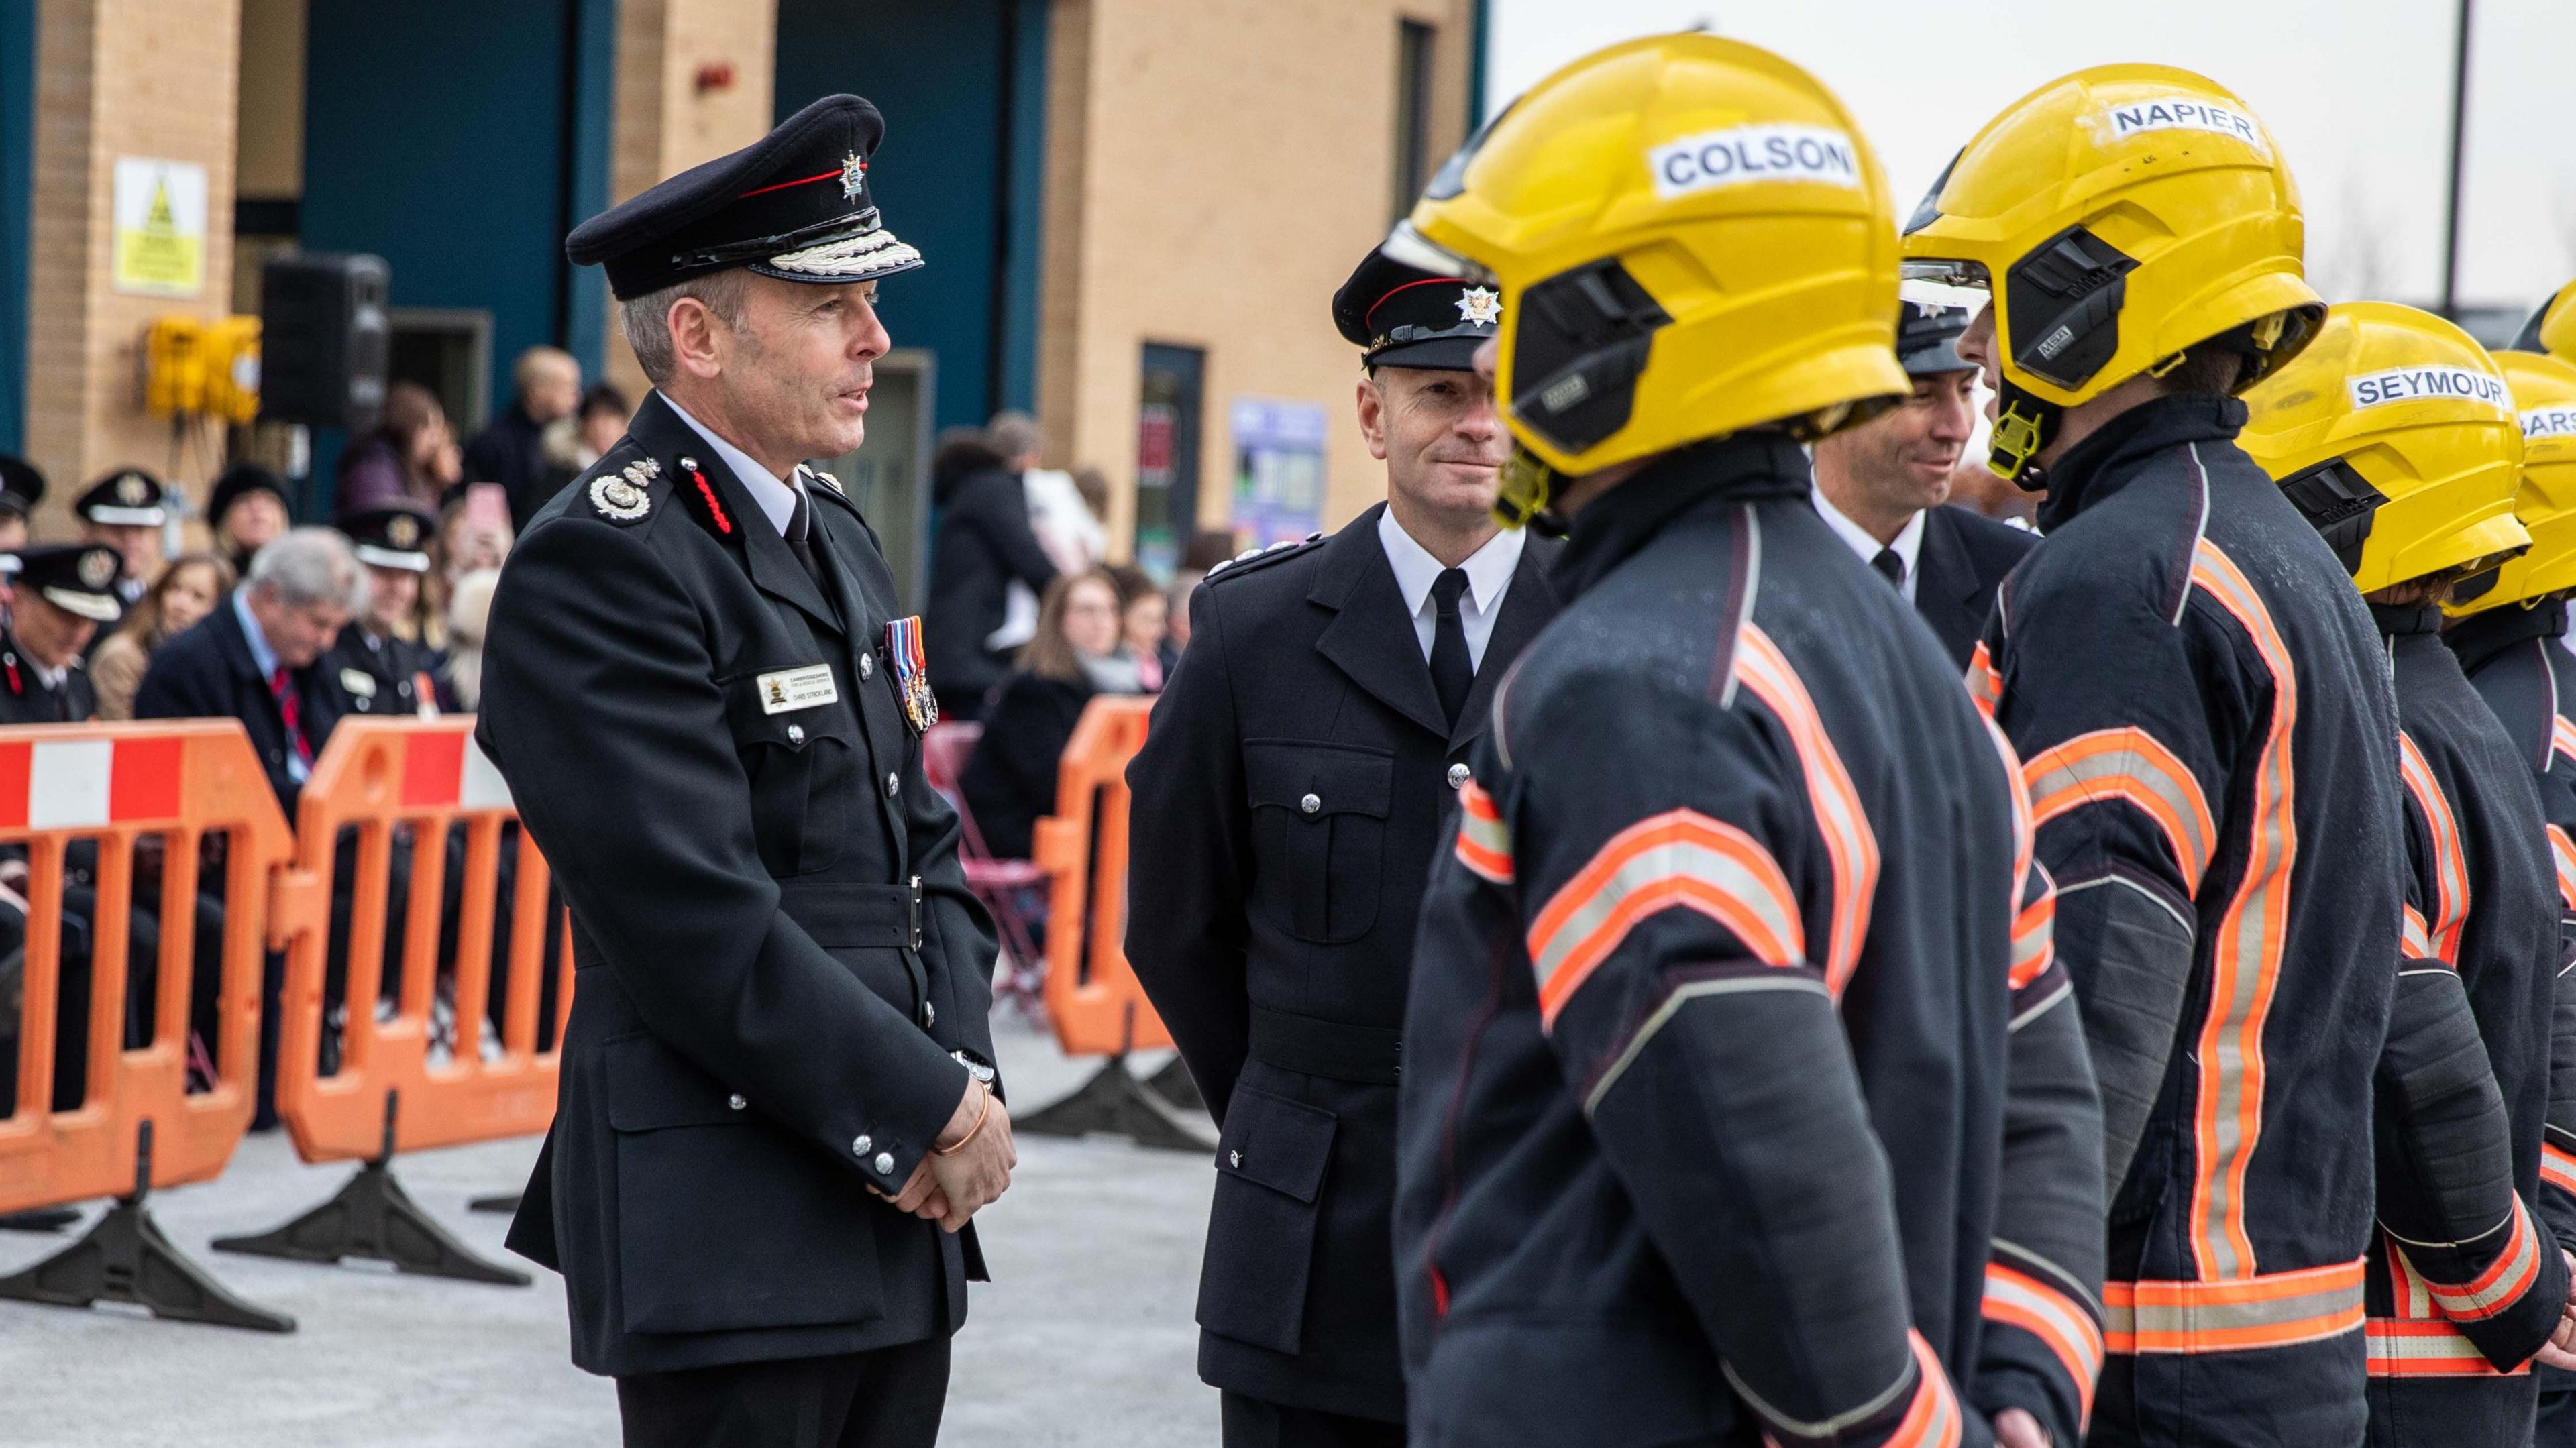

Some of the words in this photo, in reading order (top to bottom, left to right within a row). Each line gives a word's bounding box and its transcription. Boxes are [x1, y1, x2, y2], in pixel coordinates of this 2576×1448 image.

[2115, 104, 2255, 142] NAPIER
[1663, 136, 1851, 186] COLSON
[2040, 329, 2069, 355] MSA
[2357, 372, 2505, 406] SEYMOUR
